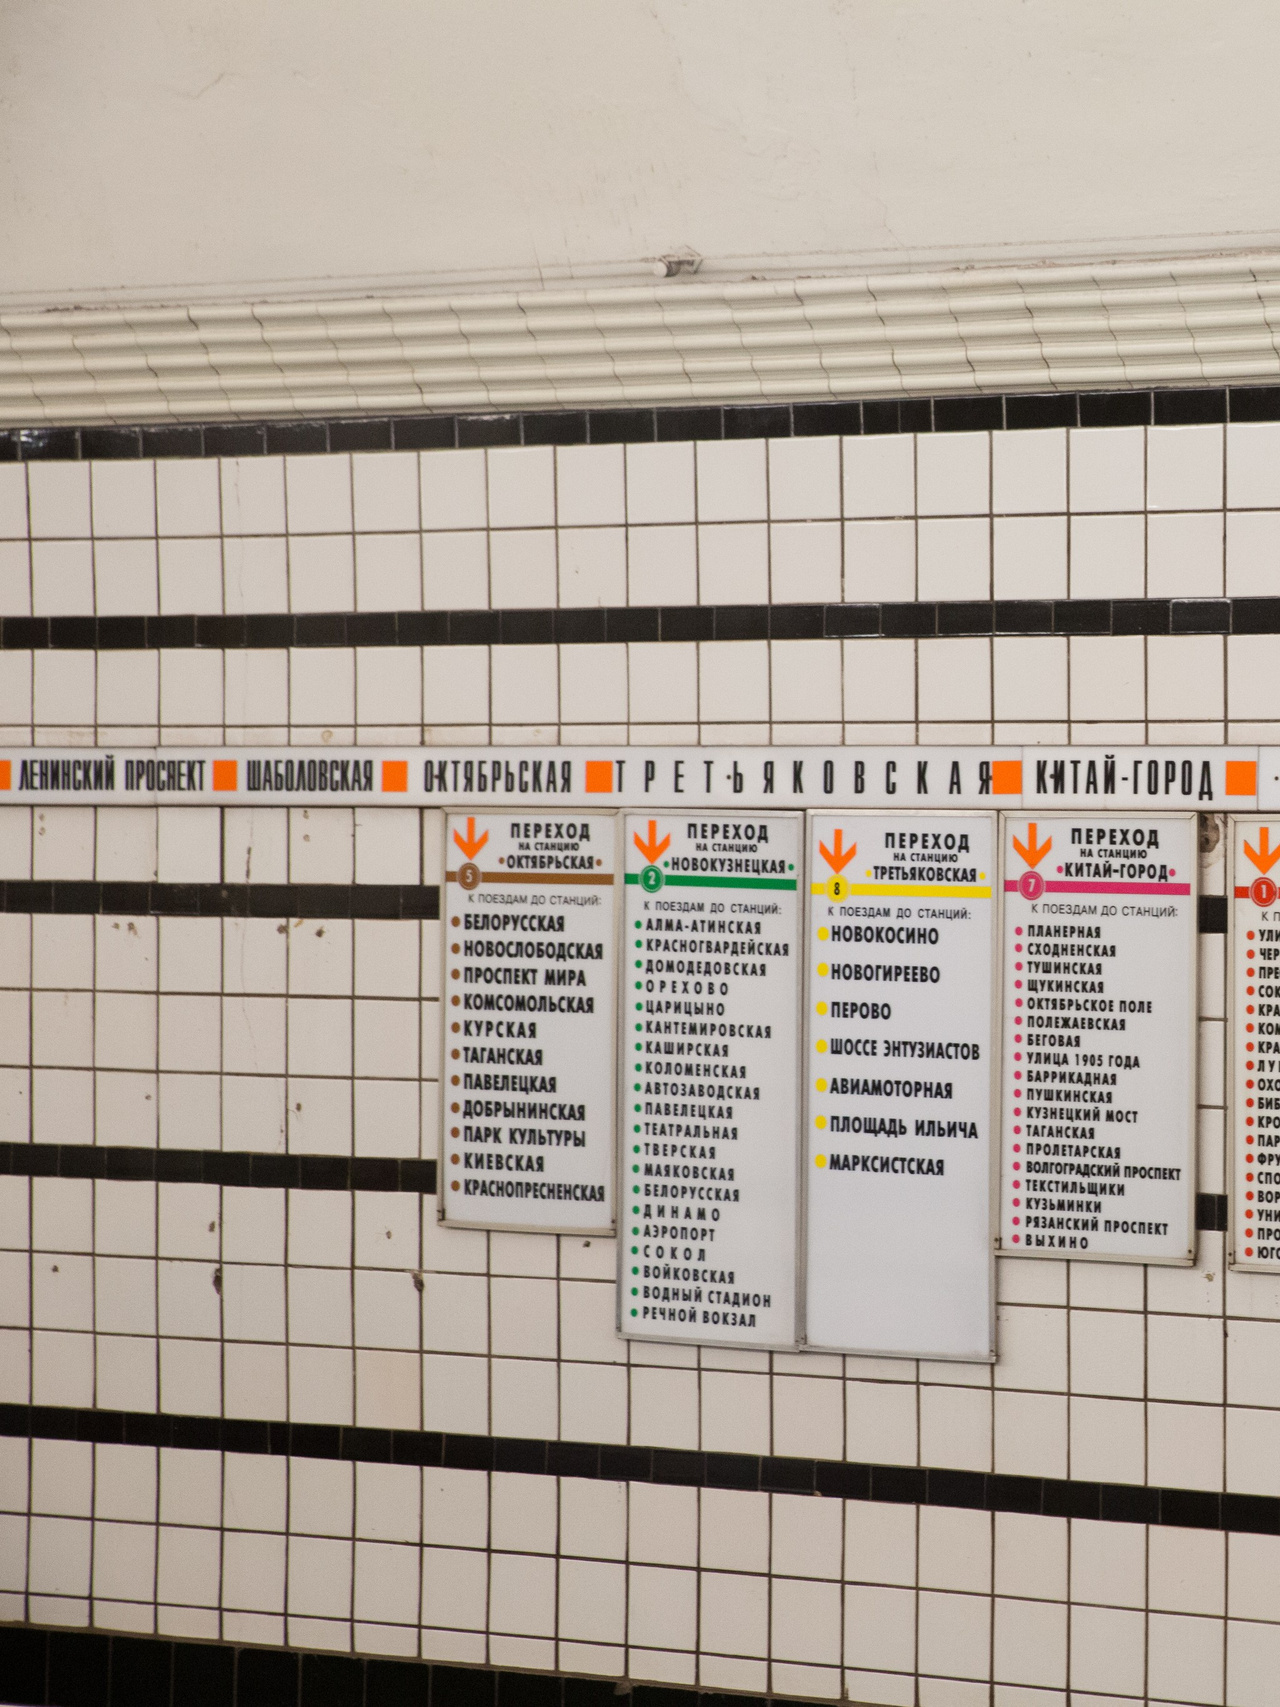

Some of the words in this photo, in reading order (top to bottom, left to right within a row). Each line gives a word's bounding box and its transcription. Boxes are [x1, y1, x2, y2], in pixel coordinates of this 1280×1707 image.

[18, 755, 115, 791] ЛЕНИНСКИЙ
[125, 759, 206, 791] ПРОСПЕКТ
[247, 760, 373, 792] ШАБОЛОВСКАЯ
[424, 760, 572, 793] ОКТЯБРЬСКАЯ
[616, 760, 991, 795] ТРЕТЬЯКОВСКАЯ
[1036, 754, 1213, 801] КИТАЙ-ГОРОД
[510, 822, 591, 841] ПЕРЕХОД
[687, 822, 769, 844] ПЕРЕХОД
[1071, 827, 1160, 848] ПЕРЕХОД
[884, 832, 971, 853] ПЕРЕХОД
[506, 854, 594, 870] ОКТЯБРЬСКАЯ
[671, 856, 786, 876] НОВОКУЗНЕЦКАЯ
[1064, 860, 1169, 883] КИТАЙ-ГОРОД
[465, 869, 473, 883] 5
[648, 871, 656, 885] 2
[872, 865, 977, 883] ТРЕТЬЯКОВСКАЯ
[833, 882, 841, 896] 8
[1027, 878, 1036, 892] 7
[1260, 884, 1267, 899] 1
[464, 913, 565, 933] БЕЛОРУССКАЯ
[827, 906, 834, 917] К
[839, 906, 891, 919] ПОЕЗДАМ
[895, 907, 912, 920] ДО
[645, 917, 761, 935] АЛМА-АТИНСКАЯ
[831, 924, 940, 946] НОВОКОСИНО
[1027, 924, 1101, 939] ПЛАНЕРНАЯ
[463, 939, 604, 963] НОВОСЛОБОДСКАЯ
[646, 938, 790, 957] КРАСНОГВАРДЕЙСКАЯ
[1027, 942, 1116, 959] СХОДНЕНСКАЯ
[463, 966, 538, 986] ПРОСПЕКТ
[543, 968, 587, 987] МИРА
[645, 958, 767, 977] ДОМОДЕДОВСКАЯ
[831, 963, 941, 984] НОВОГИРЕЕВО
[645, 979, 729, 996] ОРЕХОВО
[463, 992, 595, 1014] КОМСОМОЛЬСКАЯ
[645, 999, 725, 1017] ЦАРИЦЫНО
[830, 1001, 892, 1021] ПЕРОВО
[1026, 996, 1114, 1013] ОКТЯБРЬСКОЕ
[1119, 999, 1153, 1014] ПОЛЕ
[463, 1019, 537, 1039] КУРСКАЯ
[645, 1040, 729, 1058] КАШИРСКАЯ
[830, 1037, 878, 1057] ШОССЕ
[883, 1039, 981, 1061] ЭНТУЗИАСТОВ
[1027, 1033, 1081, 1048] БЕГОВАЯ
[462, 1046, 543, 1066] ТАГАНСКАЯ
[1026, 1051, 1070, 1068] УЛИЦА
[1074, 1053, 1104, 1068] 1905
[1108, 1054, 1141, 1071] ГОДА
[463, 1072, 557, 1096] ПАВЕЛЕЦКАЯ
[829, 1077, 953, 1100] АВИАМОТОРНАЯ
[1026, 1087, 1113, 1104] ПУШКИНСКАЯ
[462, 1099, 586, 1122] ДОБРЫНИНСКАЯ
[645, 1101, 733, 1121] ПАВЕЛЕЦКАЯ
[1026, 1105, 1101, 1123] КУЗНЕЦКИЙ
[1105, 1109, 1139, 1124] МОСТ
[463, 1125, 503, 1144] ПАРК
[508, 1127, 586, 1148] КУЛЬТУРЫ
[830, 1115, 908, 1139] ПЛОЩАДЬ
[914, 1119, 979, 1140] ИЛЬИЧА
[1025, 1124, 1095, 1140] ТАГАНСКАЯ
[1026, 1142, 1121, 1160] ПРОЛЕТАРСКАЯ
[463, 1152, 545, 1173] КИЕВСКАЯ
[829, 1153, 945, 1177] МАРКСИСТСКАЯ
[463, 1178, 605, 1203] КРАСНОПРЕСНЕНСКАЯ
[644, 1183, 740, 1203] БЕЛОРУССКАЯ
[643, 1203, 721, 1222] ДИНАМО
[643, 1224, 716, 1242] АЭРОПОРТ
[1025, 1215, 1099, 1232] РЯЗАНСКИЙ
[1103, 1219, 1169, 1236] ПРОСПЕКТ
[1025, 1233, 1090, 1250] ВЫХИНО
[643, 1244, 706, 1262] СОКОЛ
[643, 1285, 703, 1303] ВОДНЫЙ
[707, 1289, 771, 1308] СТАДИОН
[642, 1305, 697, 1323] РЕЧНОЙ
[702, 1310, 756, 1327] ВОКЗАЛ
